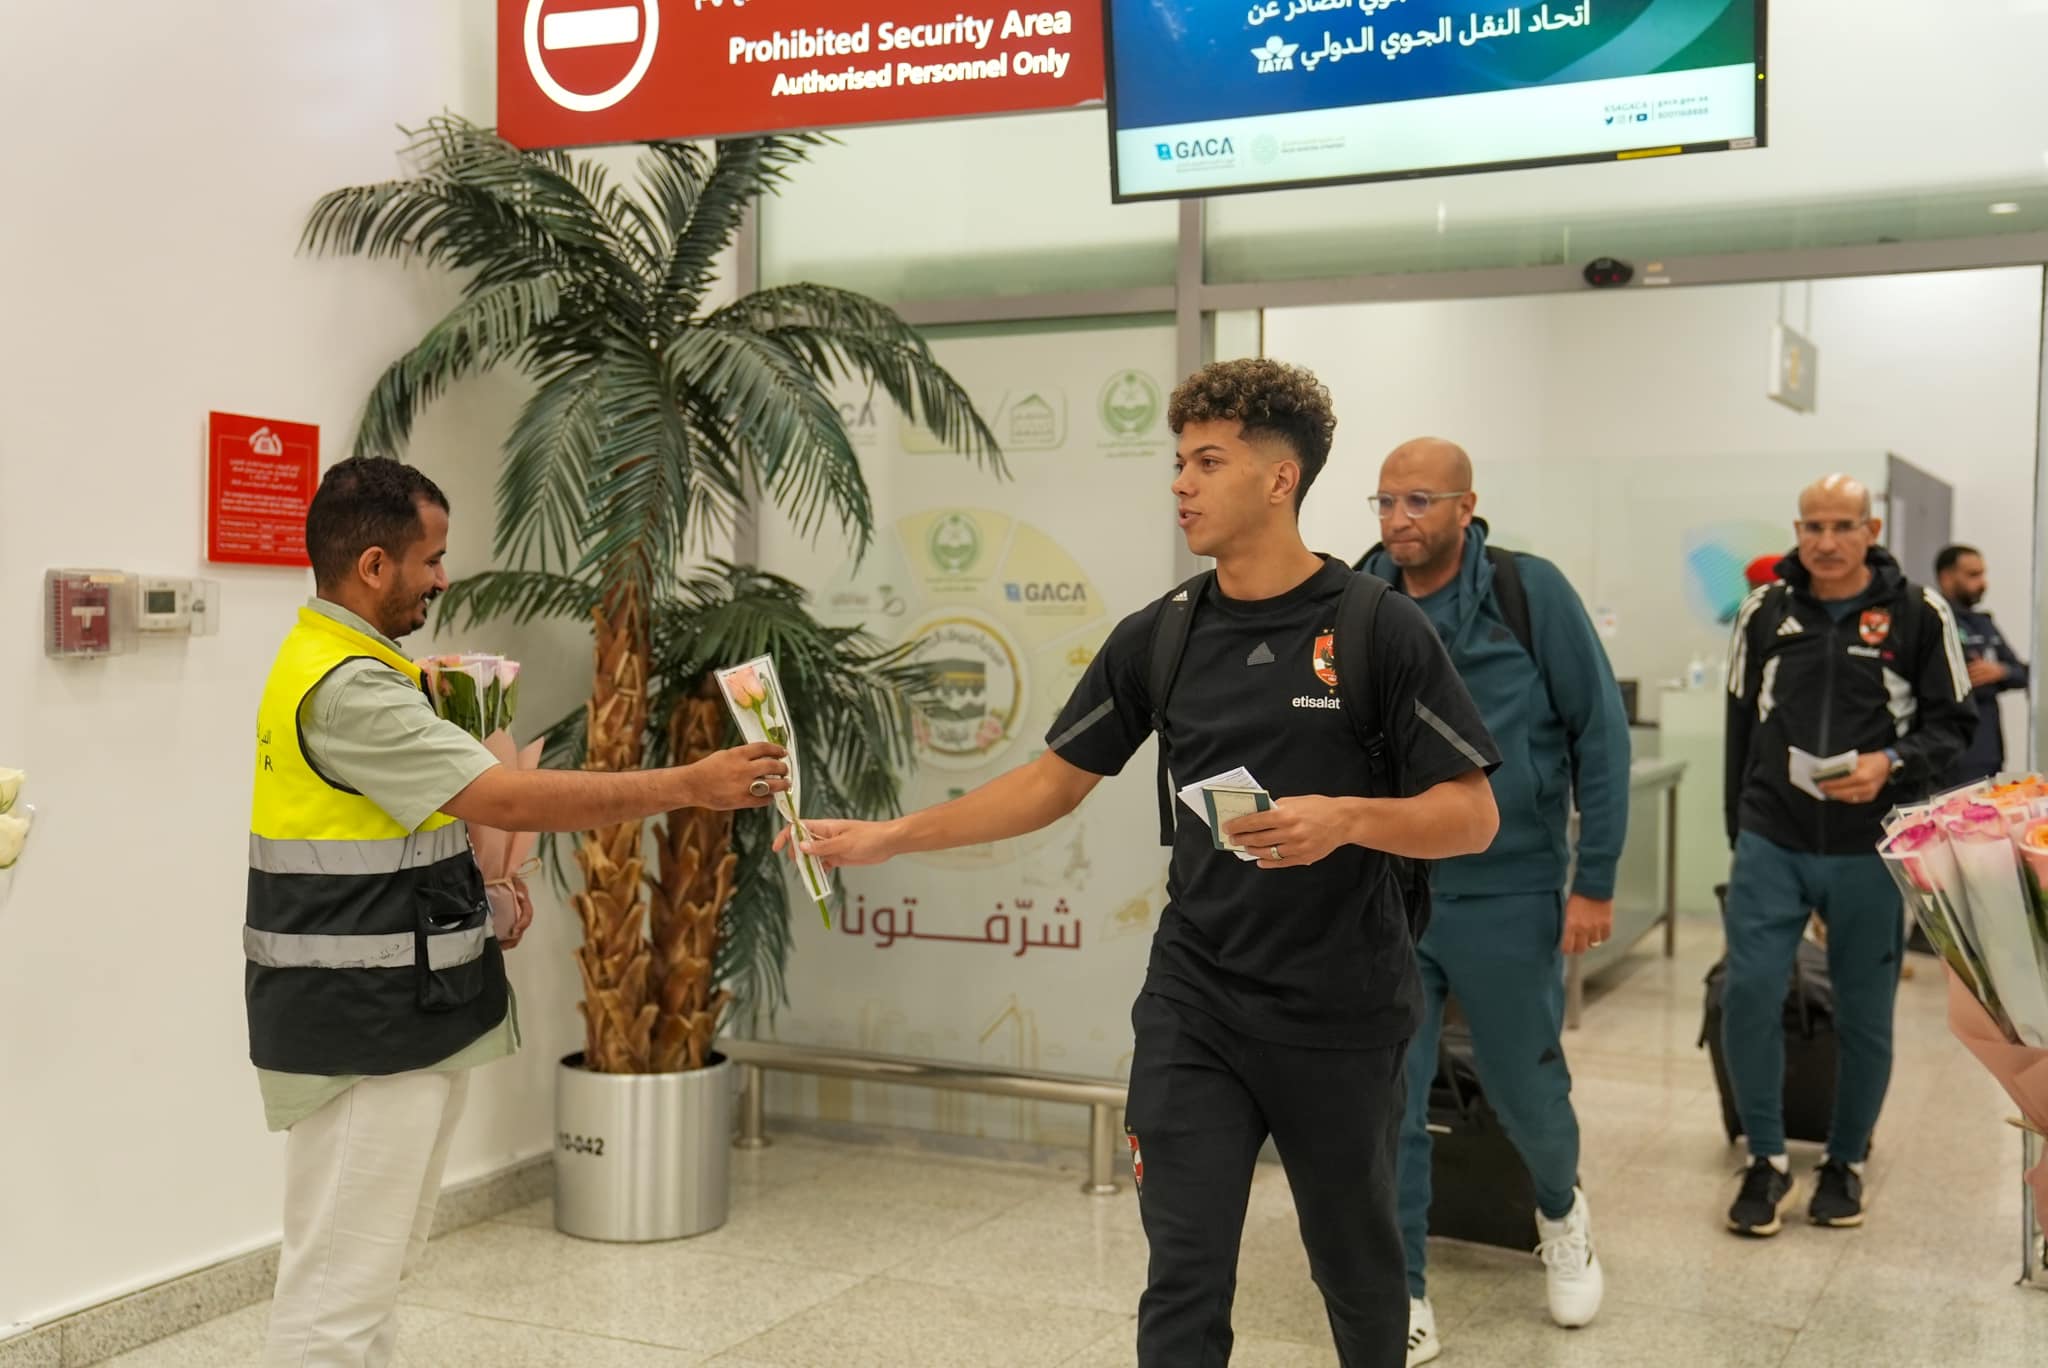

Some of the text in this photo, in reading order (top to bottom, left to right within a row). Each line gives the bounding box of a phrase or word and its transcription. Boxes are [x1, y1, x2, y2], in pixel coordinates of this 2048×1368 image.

[728, 9, 1072, 65] Prohibited Security Area
[1380, 16, 1452, 61] الجوي
[1458, 7, 1520, 47] النقل
[1257, 57, 1294, 74] IATA
[1300, 25, 1374, 72] الدولي
[771, 47, 1070, 97] Authorised Personnel Only
[1175, 137, 1235, 160] GACA
[1024, 582, 1087, 603] GACA
[1291, 695, 1341, 710] etisalat
